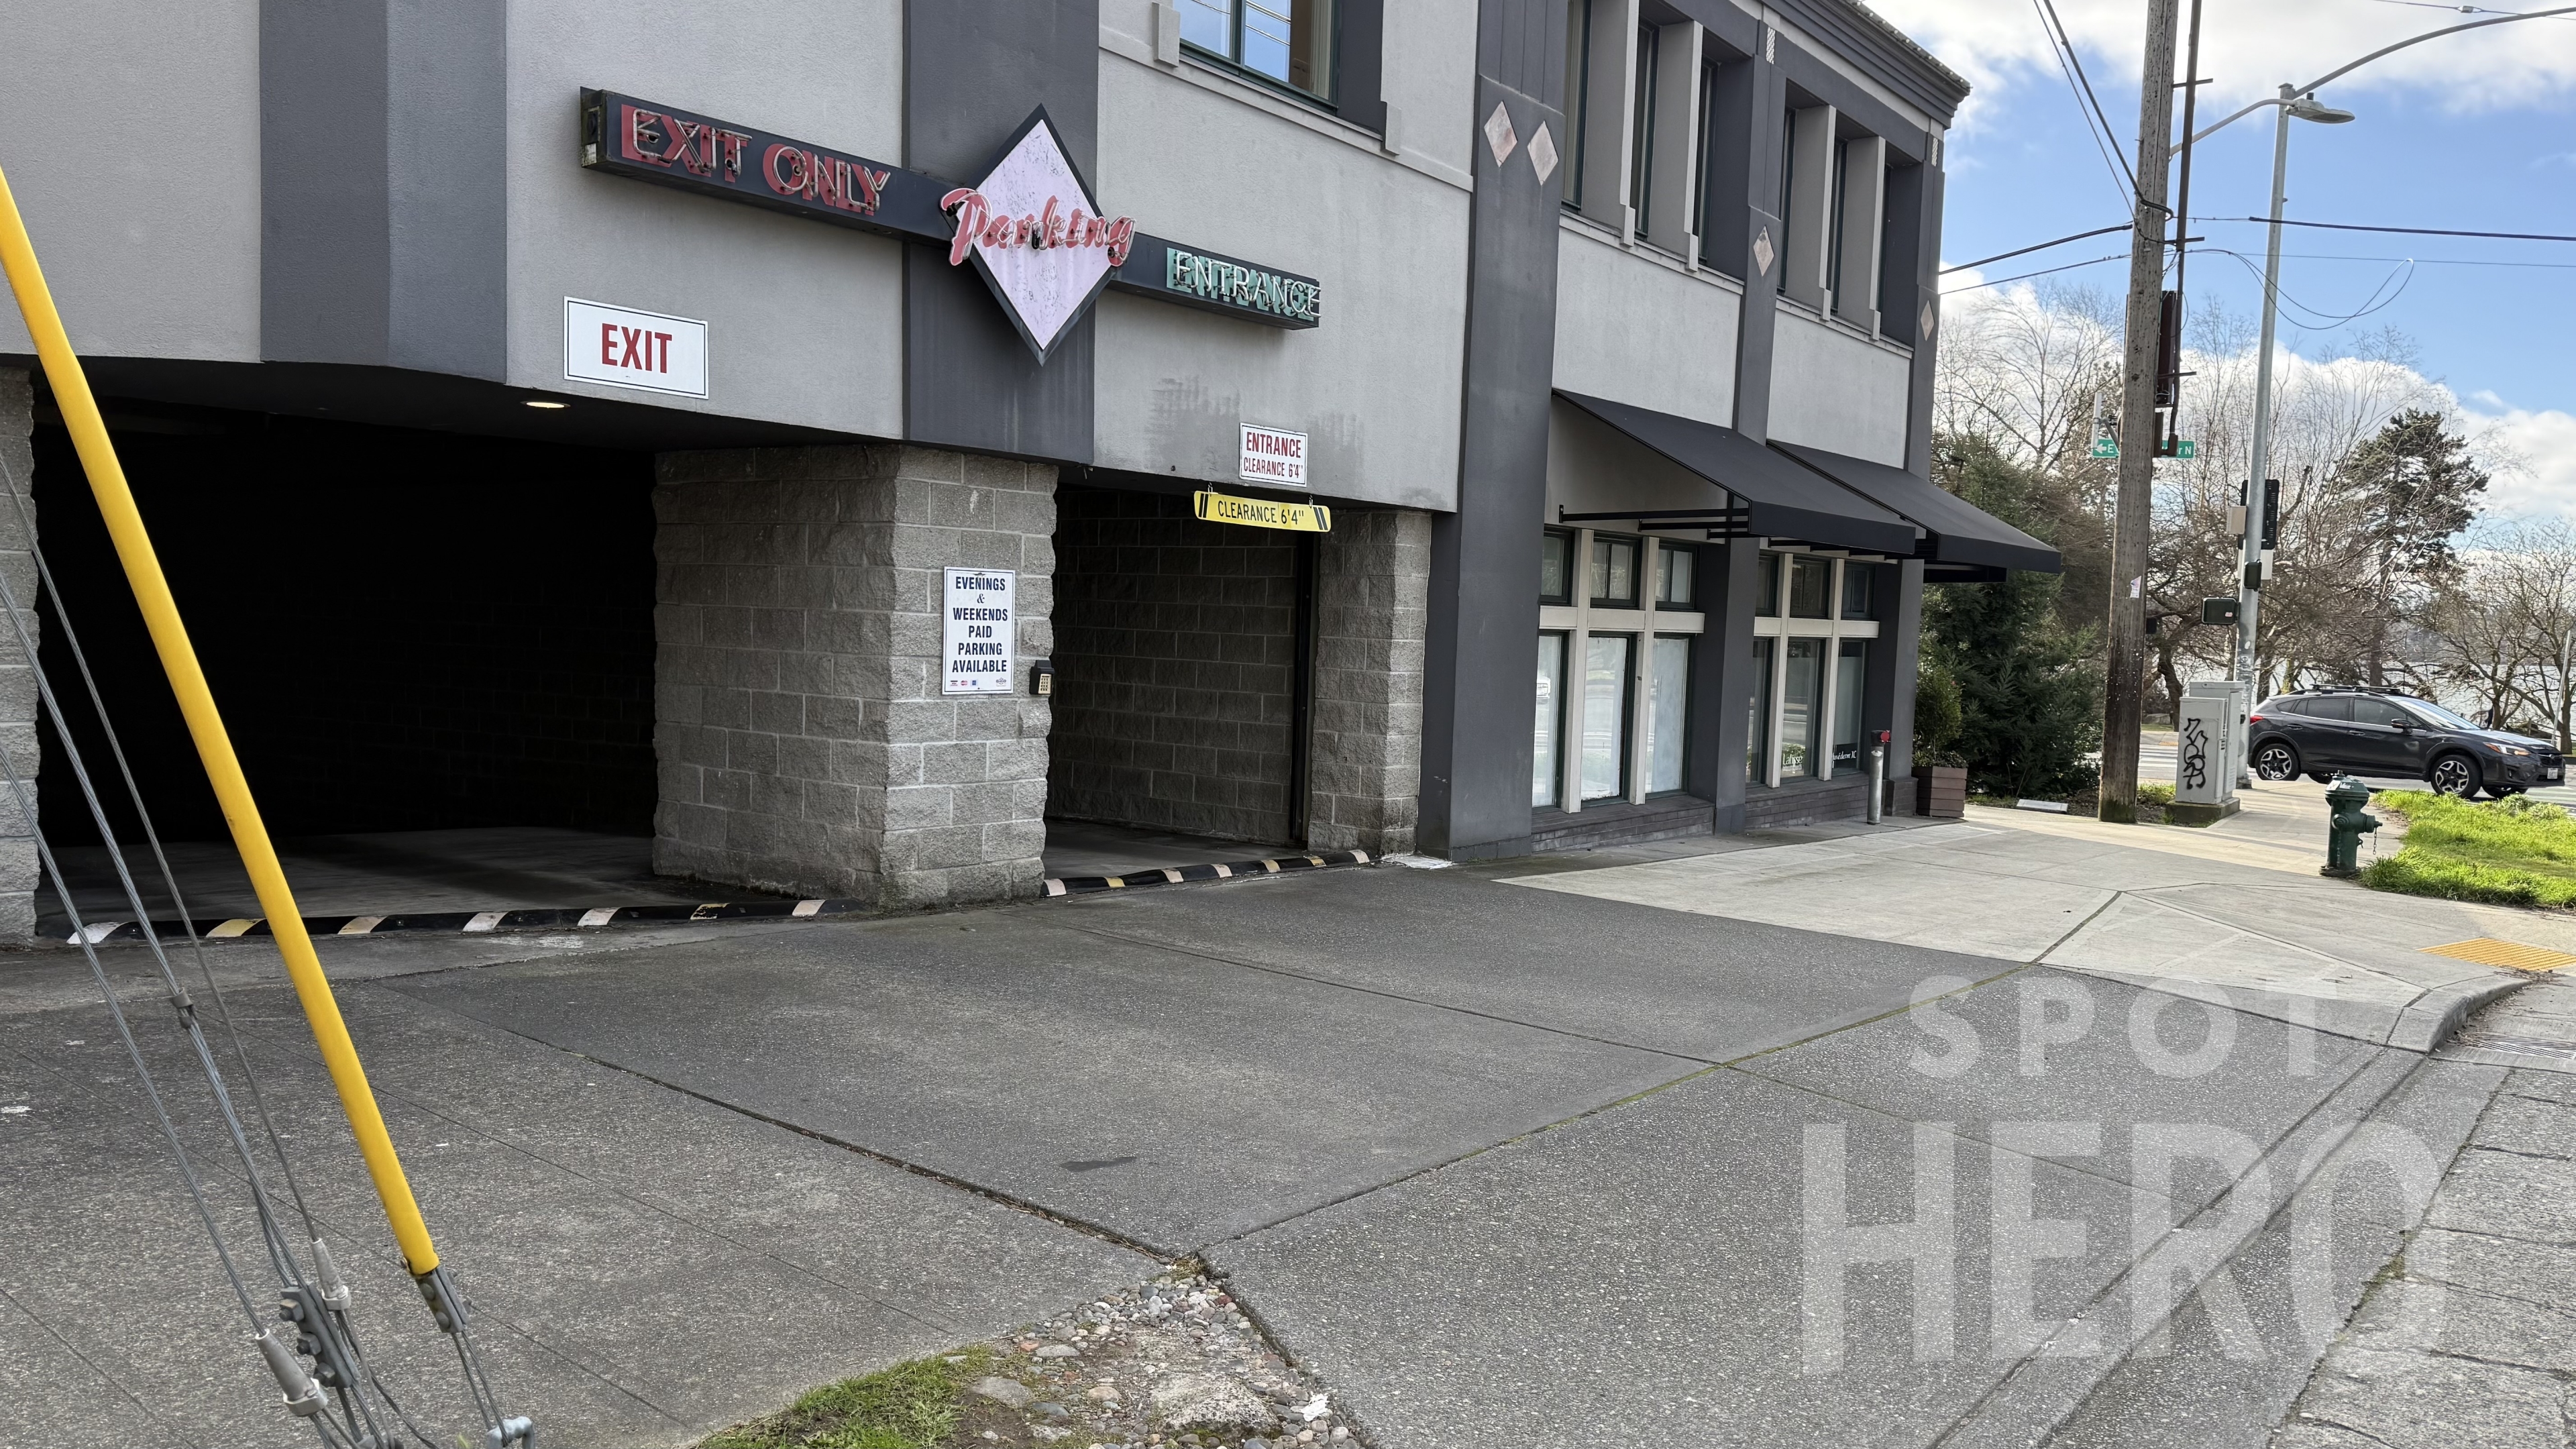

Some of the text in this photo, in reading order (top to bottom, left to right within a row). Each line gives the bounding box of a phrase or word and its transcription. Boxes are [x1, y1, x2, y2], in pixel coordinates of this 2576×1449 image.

[621, 104, 891, 216] EXIT ONLY
[940, 187, 1137, 267] Parking
[1167, 247, 1322, 322] ENTRANCE
[602, 323, 673, 374] EXIT
[1246, 431, 1301, 458] ENTRANCE
[1244, 457, 1285, 477] CLEARANCE
[1218, 500, 1304, 525] CLEARANCE 6'4"
[955, 576, 1006, 591] EVENINGS
[977, 593, 985, 604] &
[953, 607, 1008, 621] WEEKENDS
[968, 625, 992, 638] PAID
[958, 642, 1002, 655] PARKING
[952, 659, 1007, 673] AVAILABLE
